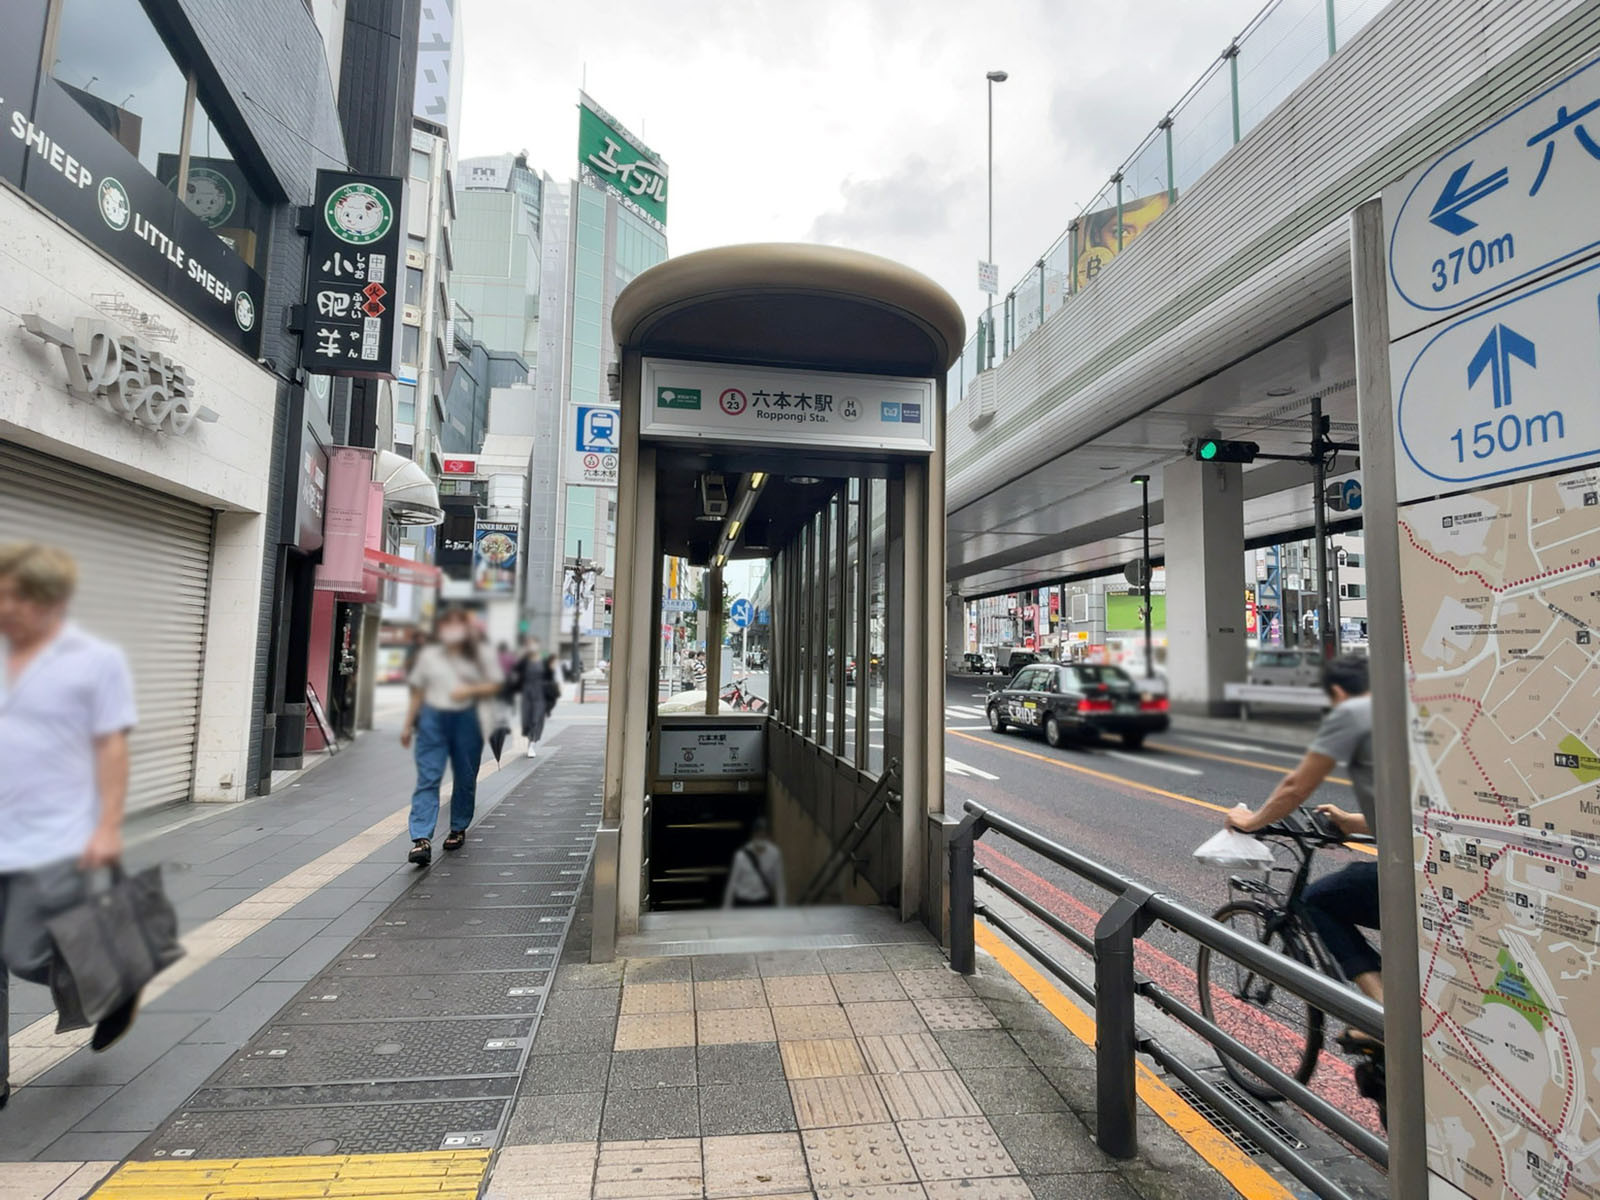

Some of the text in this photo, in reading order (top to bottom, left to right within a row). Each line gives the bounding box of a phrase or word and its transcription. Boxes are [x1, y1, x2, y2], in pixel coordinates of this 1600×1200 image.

[588, 136, 667, 202] エイブル
[134, 213, 232, 304] LITTLE SHEEP
[1431, 231, 1515, 292] 370m
[730, 392, 736, 401] E
[752, 389, 833, 413] 六本木駅
[726, 401, 740, 410] 23
[847, 400, 855, 409] H
[756, 409, 829, 423] Roppongi Sta.
[844, 408, 857, 417] 04
[1450, 410, 1565, 464] 150m
[496, 523, 517, 531] BEAUTY
